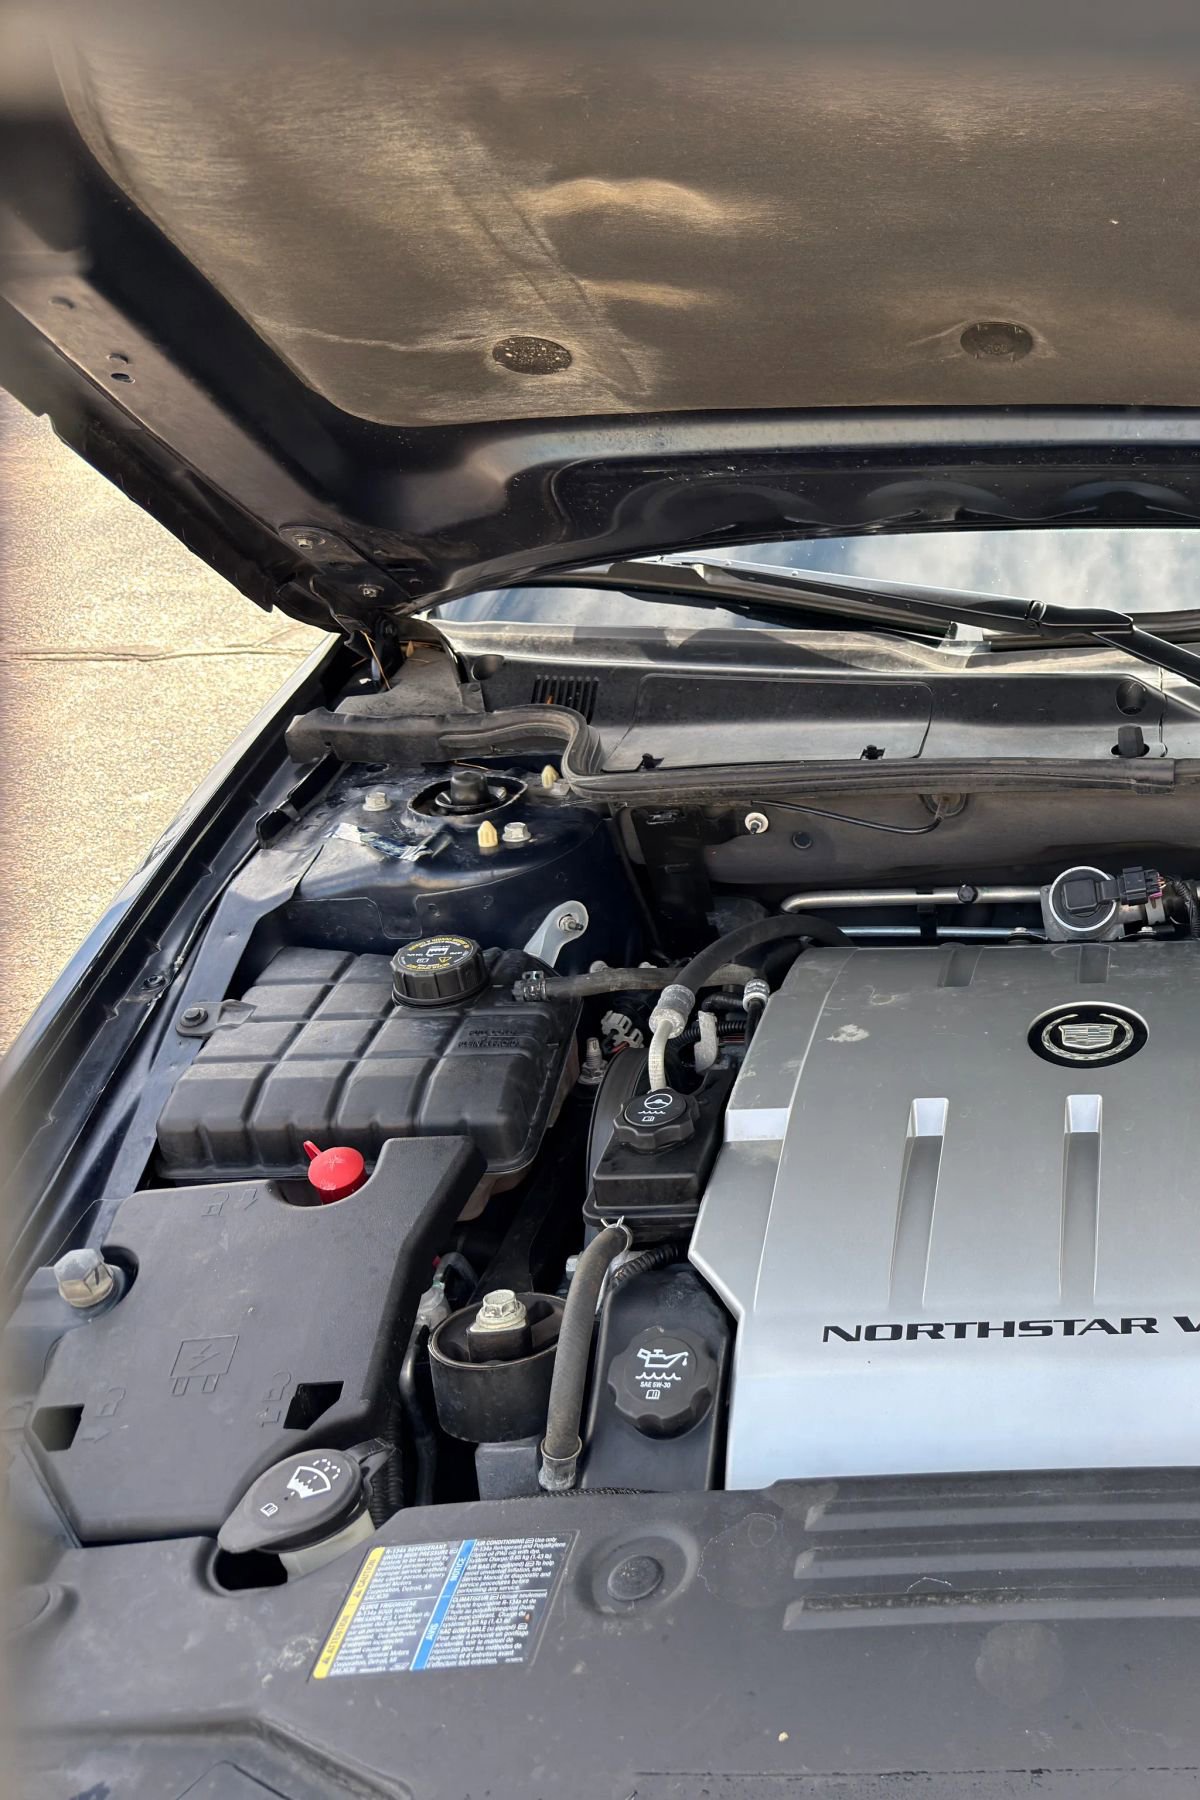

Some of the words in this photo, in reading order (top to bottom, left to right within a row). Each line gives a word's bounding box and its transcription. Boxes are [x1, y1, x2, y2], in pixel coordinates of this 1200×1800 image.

[822, 1317, 1159, 1343] NORTHSTAR
[449, 1557, 467, 1582] NOTICE
[425, 1623, 439, 1641] AVIS
